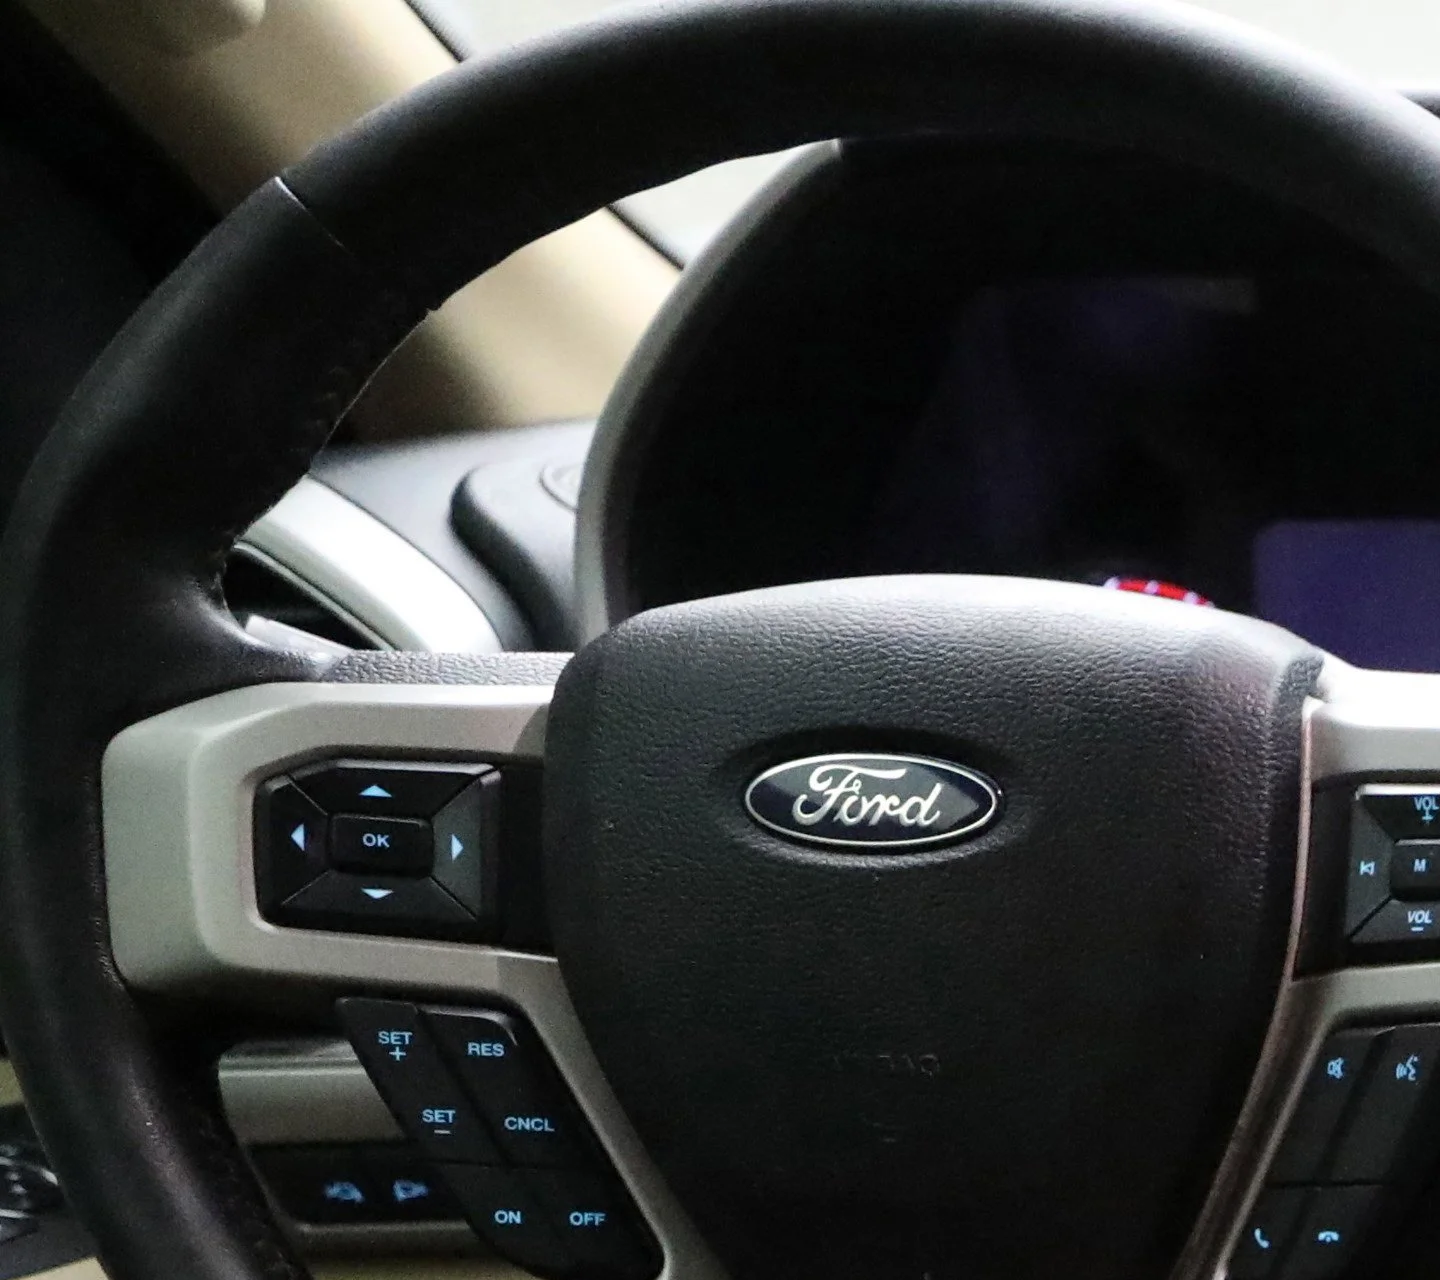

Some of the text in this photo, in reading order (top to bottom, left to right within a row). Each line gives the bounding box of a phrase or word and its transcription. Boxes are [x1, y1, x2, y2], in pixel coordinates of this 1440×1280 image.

[791, 763, 943, 827] Ford
[1414, 796, 1440, 811] VOL
[362, 833, 390, 848] OK
[1413, 858, 1426, 873] M
[1407, 909, 1433, 924] VOL
[377, 1030, 413, 1046] SET
[467, 1041, 505, 1058] RES
[421, 1108, 456, 1124] SET
[503, 1116, 555, 1132] CNCL
[494, 1209, 522, 1225] ON
[569, 1211, 606, 1227] OFF
